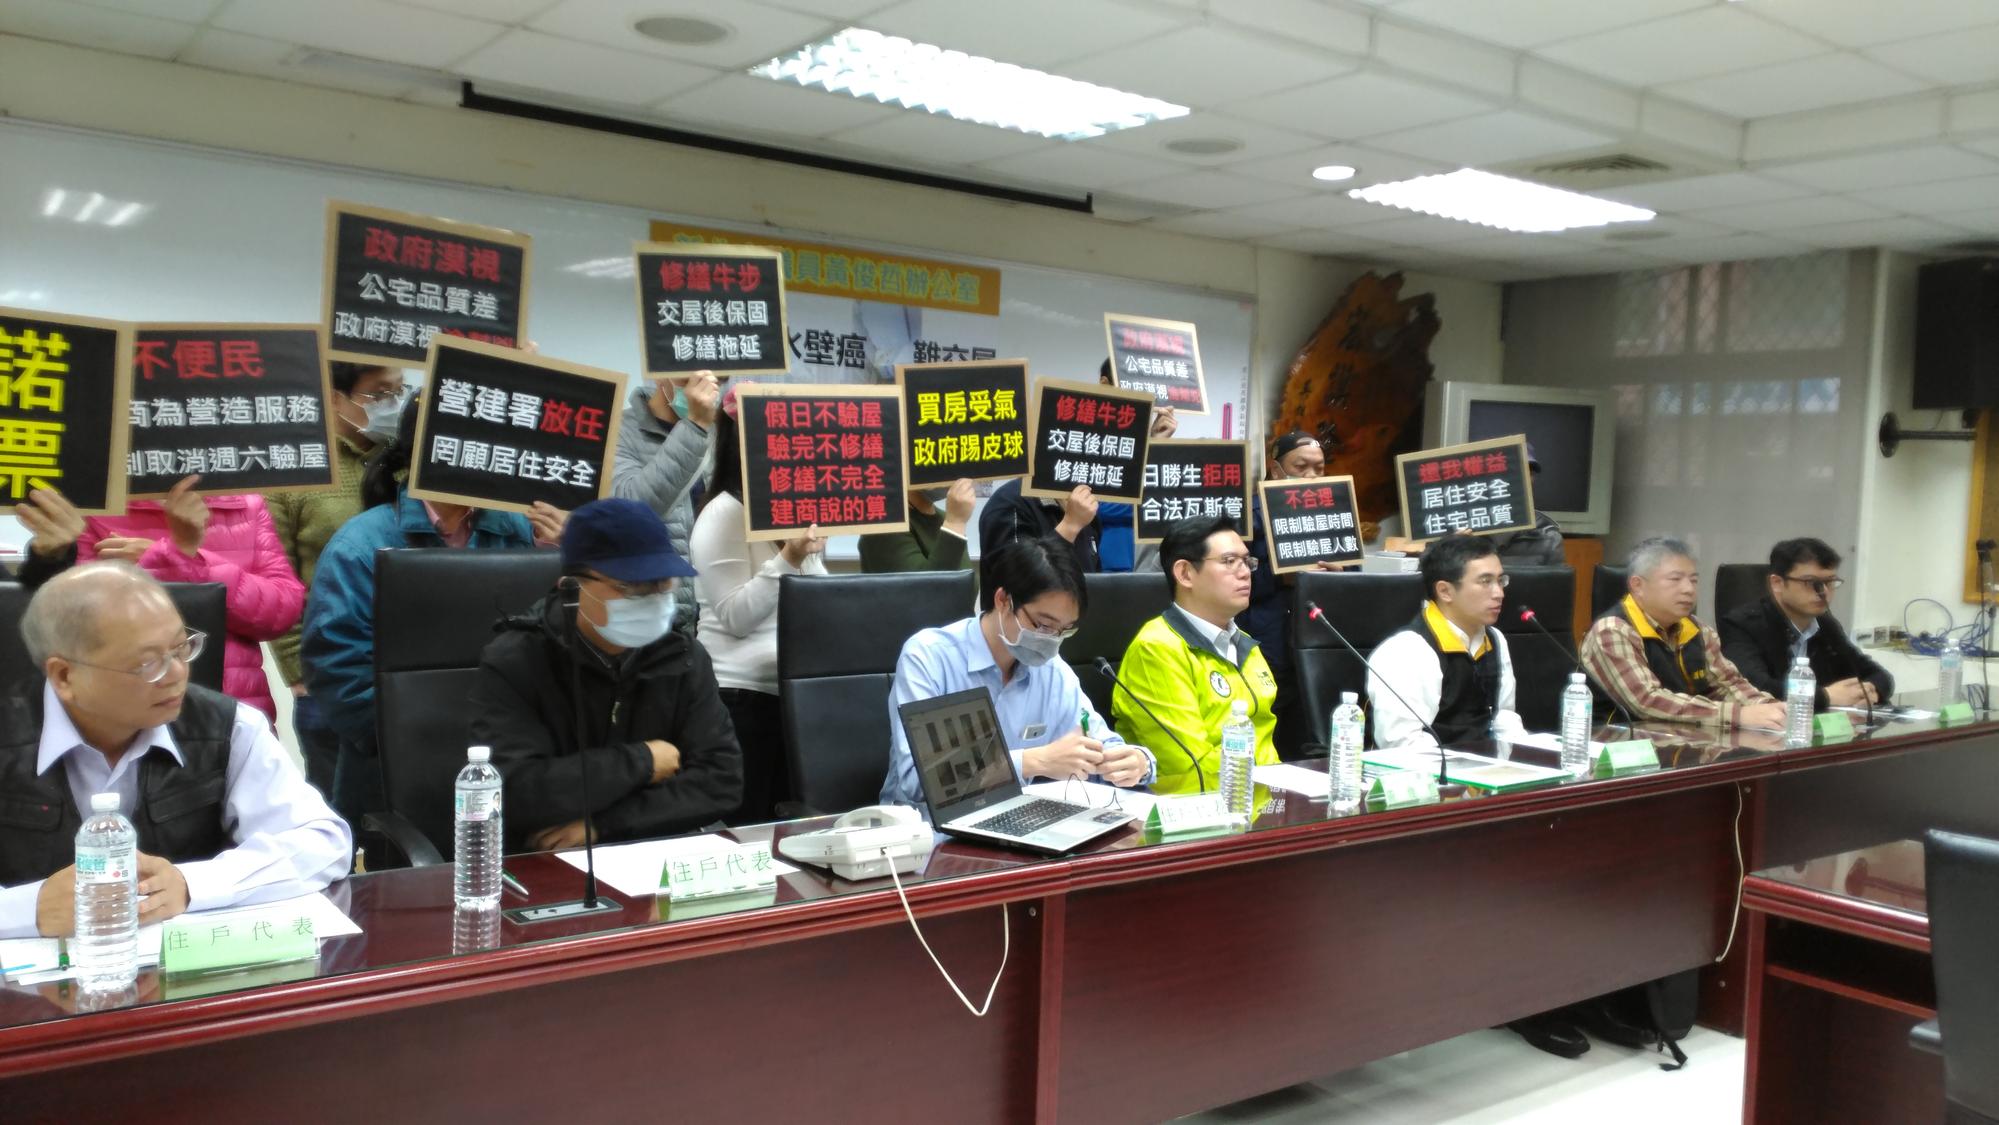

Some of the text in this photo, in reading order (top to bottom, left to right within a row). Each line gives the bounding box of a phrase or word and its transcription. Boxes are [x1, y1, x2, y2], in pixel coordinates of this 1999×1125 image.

[364, 227, 501, 282] 政府漠視
[660, 261, 762, 292] 修繕牛步
[358, 272, 500, 320] 公宅品質差
[657, 300, 768, 326] 交屋後保固
[133, 340, 266, 380] 不便民
[672, 334, 762, 361] 修繕拖延
[1125, 355, 1189, 379] 公宅品質差
[437, 378, 605, 440] 營建署放任
[765, 401, 883, 428] 假日不驗屋
[917, 389, 1017, 425] 買房受氣
[1056, 395, 1136, 429] 修繕牛步
[0, 419, 65, 498] 票
[767, 433, 884, 461] 驗完不修繕
[914, 431, 1024, 466] 政府踢皮球
[1048, 429, 1135, 459] 交屋後保固
[430, 435, 596, 488] 罔顧居住安全
[1054, 459, 1124, 487] 修繕拖延
[1143, 463, 1241, 487] 日勝生拒用
[768, 464, 885, 493] 修繕不完全
[1422, 478, 1511, 509] 居住安全
[771, 495, 887, 525] 建商說的算
[1142, 497, 1243, 522] 合法瓦斯管
[1284, 487, 1334, 509] 不合理
[1275, 512, 1353, 535] 限制驗屋時間
[1424, 504, 1513, 534] 住宅品質
[1278, 536, 1358, 560] 限制驗屋人數
[673, 850, 773, 883] 住戶代表
[168, 916, 314, 951] 住戶代表
